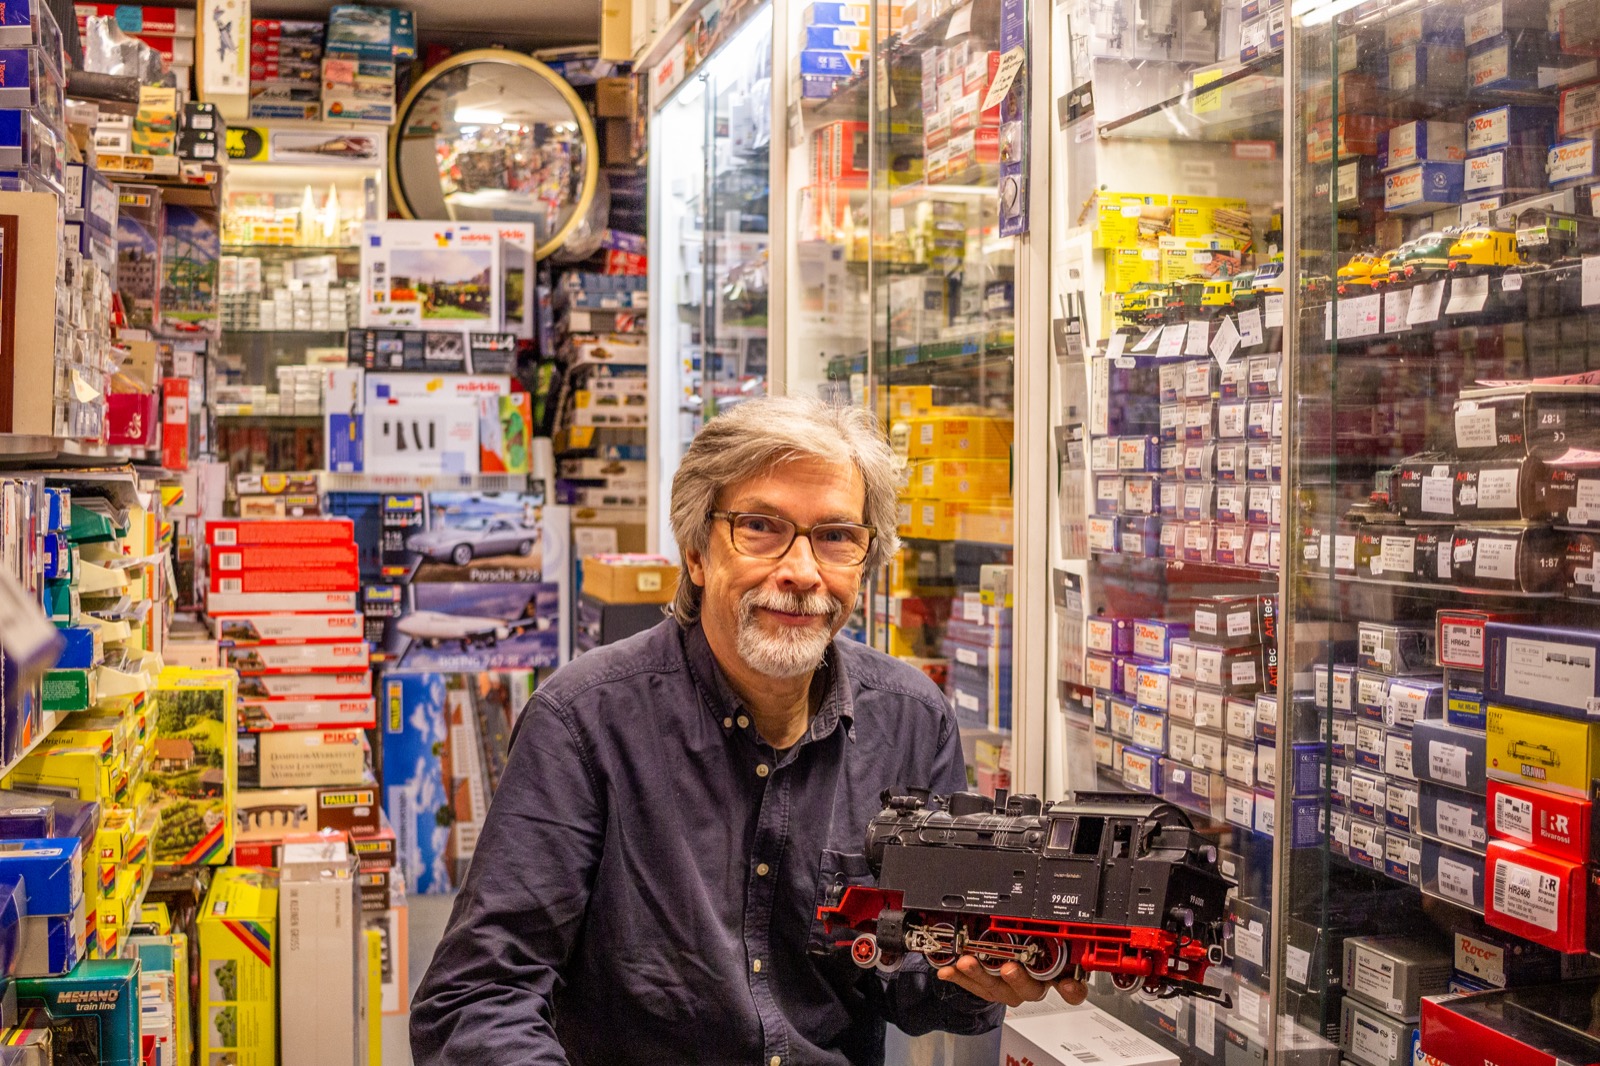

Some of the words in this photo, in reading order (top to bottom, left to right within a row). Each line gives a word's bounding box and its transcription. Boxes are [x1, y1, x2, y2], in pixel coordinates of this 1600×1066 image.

[1393, 173, 1421, 188] Roco
[1540, 558, 1559, 568] 1:87
[470, 567, 515, 581] Porsche
[328, 618, 357, 627] PIKO
[1264, 598, 1275, 638] Artitec
[333, 646, 361, 656] PIKO
[1143, 675, 1157, 688] Roc
[339, 703, 368, 713] PIKO
[324, 732, 357, 744] PIKO
[1521, 764, 1546, 780] BRAWA
[1540, 828, 1570, 844] Rivarossi
[1508, 883, 1531, 899] HR2466
[1051, 894, 1061, 903] 99
[1062, 895, 1079, 904] 6001
[1461, 937, 1498, 960] Roco
[76, 1003, 98, 1011] train
[99, 1002, 116, 1011] line
